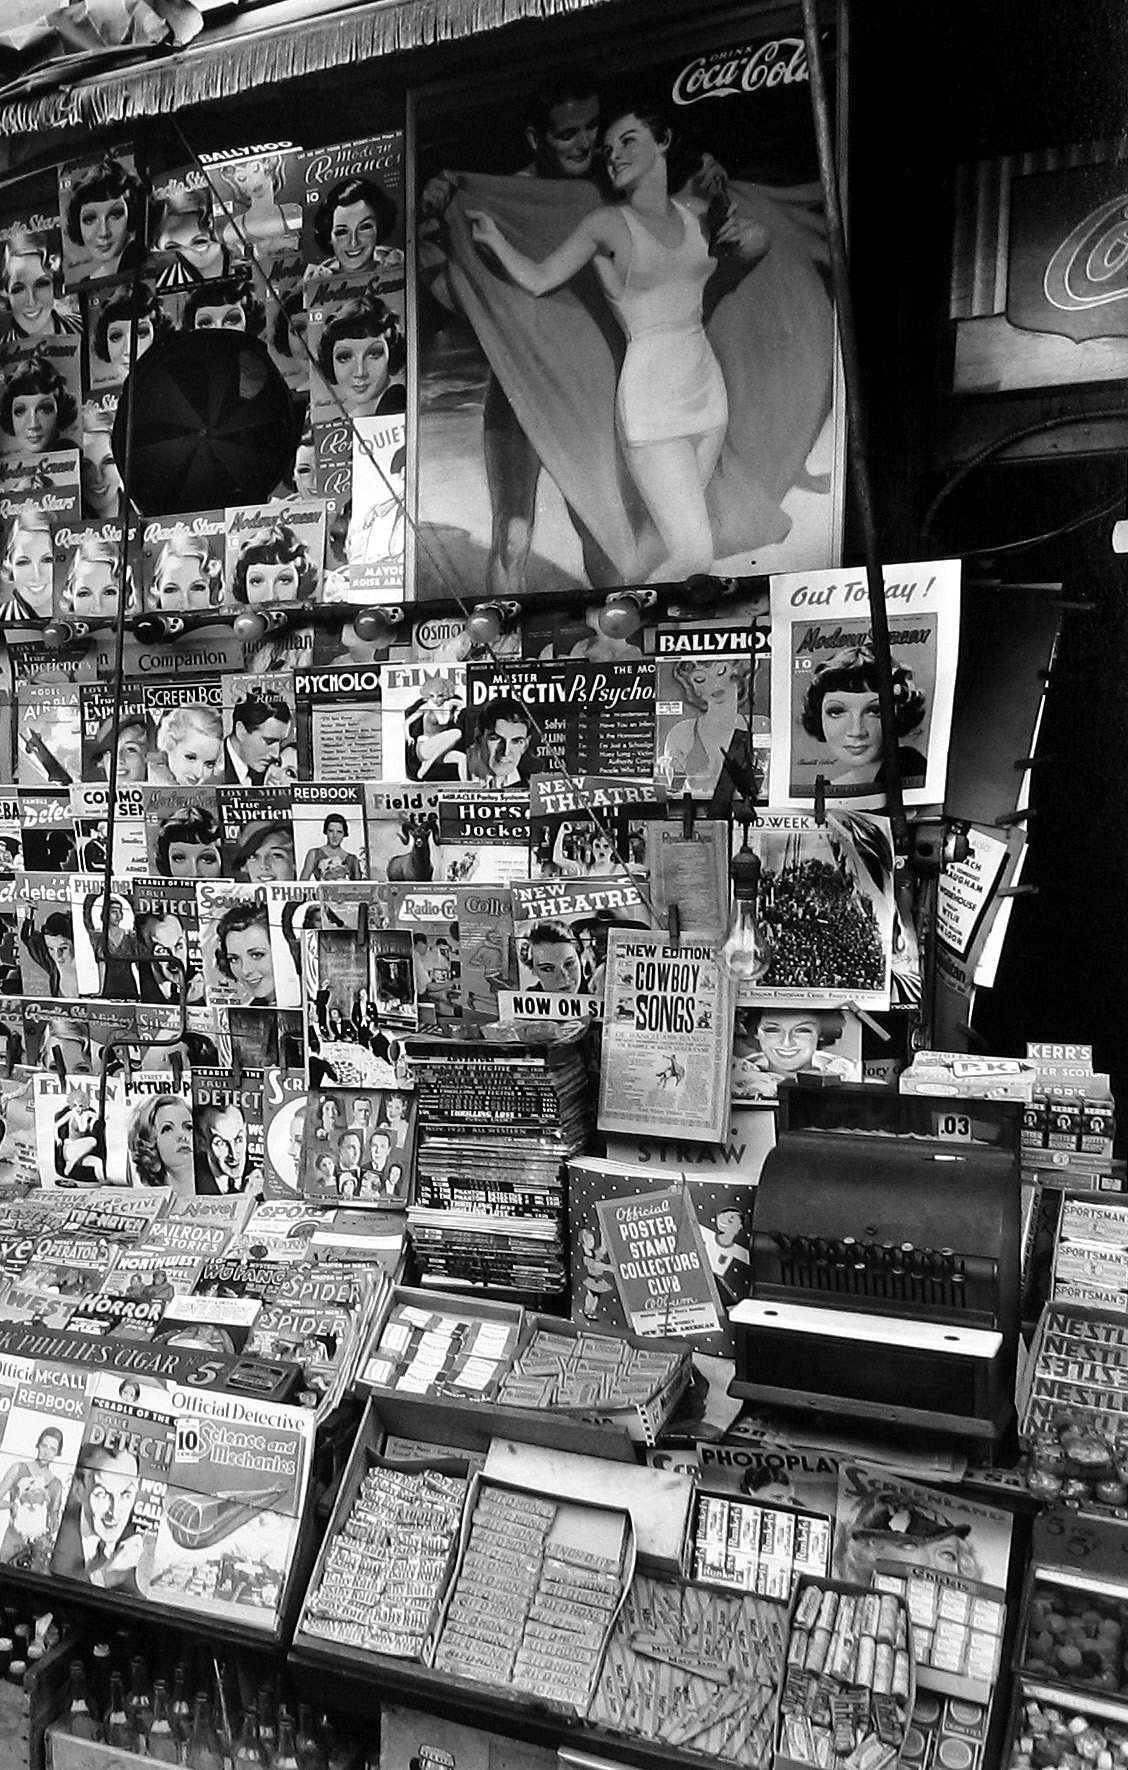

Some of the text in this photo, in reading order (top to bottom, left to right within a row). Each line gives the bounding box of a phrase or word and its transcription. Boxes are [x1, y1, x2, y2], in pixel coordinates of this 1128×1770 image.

[198, 141, 293, 166] BALLYHOO
[306, 192, 319, 203] 10
[790, 583, 837, 607] Out
[138, 649, 228, 672] Companion
[614, 665, 633, 674] THE
[794, 659, 812, 670] 10
[147, 687, 197, 709] SCREEN
[588, 673, 656, 709] Psycho
[294, 787, 357, 799] REDBOOK
[537, 777, 585, 794] NEW
[373, 793, 421, 810] Field
[224, 826, 240, 839] 10
[519, 884, 566, 901] NEW
[522, 886, 642, 920] THEATRE
[626, 944, 711, 960] NEW EDITION
[635, 961, 700, 994] COWBOY
[514, 997, 581, 1016] NOW ON
[635, 994, 695, 1033] SONGS
[1028, 1044, 1091, 1060] KERR'S
[197, 1089, 262, 1109] DETECT
[940, 1115, 969, 1135] .03
[637, 1143, 747, 1164] STRAW
[183, 1201, 237, 1218] Novel
[615, 1200, 671, 1223] Official
[149, 1223, 224, 1243] RAILROAD
[618, 1215, 678, 1242] POSTER
[36, 1239, 98, 1262] OPERATOR
[162, 1238, 219, 1252] STORIES
[628, 1236, 677, 1259] STAMP
[120, 1254, 202, 1271] NORTHWEST
[619, 1252, 700, 1280] COLLECTORS
[281, 1274, 362, 1303] SPIDER
[647, 1275, 681, 1296] CLUB
[75, 1293, 163, 1321] HORROR
[264, 1306, 347, 1337] SPIDER
[114, 1344, 180, 1372] CIGAR
[35, 1369, 86, 1391] McCALL
[187, 1361, 224, 1386] 5
[19, 1388, 85, 1415] REDBOOK
[99, 1400, 171, 1424] CRADLE OF THE
[172, 1392, 306, 1432] Official Detective
[178, 1429, 199, 1451] 10
[199, 1421, 295, 1455] Science and
[208, 1446, 296, 1475] Mechanics
[701, 1448, 841, 1474] PHOTOPLAY
